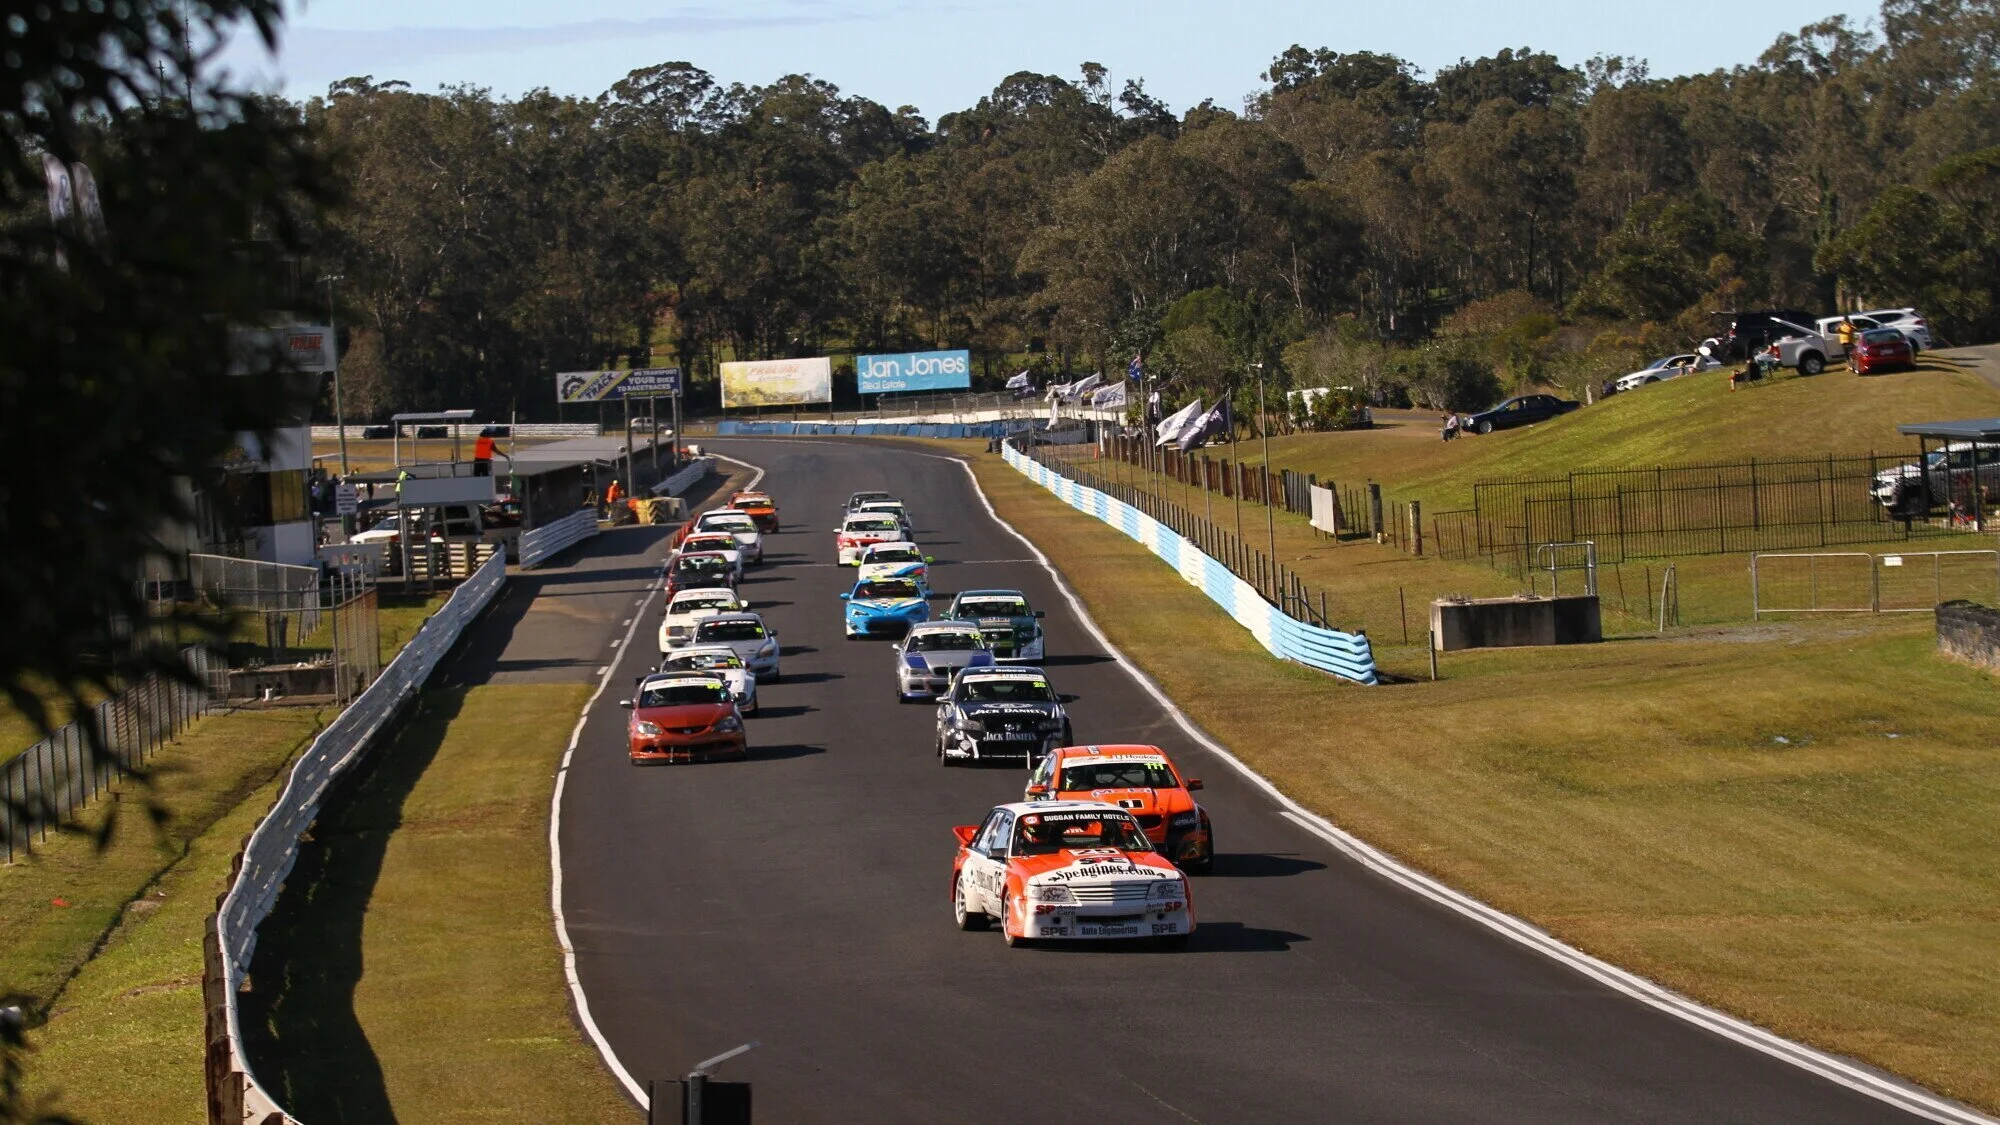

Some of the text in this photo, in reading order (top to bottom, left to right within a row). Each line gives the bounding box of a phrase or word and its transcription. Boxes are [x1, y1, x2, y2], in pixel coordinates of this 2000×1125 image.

[862, 354, 966, 379] Jan Jones
[627, 376, 675, 385] YOUR BIKE
[862, 380, 906, 391] Real Estate
[983, 731, 1004, 742] JACK
[1043, 814, 1075, 822] DUGGAN
[1102, 813, 1130, 821] HOTELS
[1121, 822, 1135, 831] 25
[1055, 863, 1156, 880] Spengines.com
[1035, 904, 1056, 916] SP
[1164, 901, 1183, 913] SP
[1040, 926, 1068, 937] SPE
[1081, 925, 1138, 936] Auto Engineering
[1151, 923, 1178, 934] SPE
